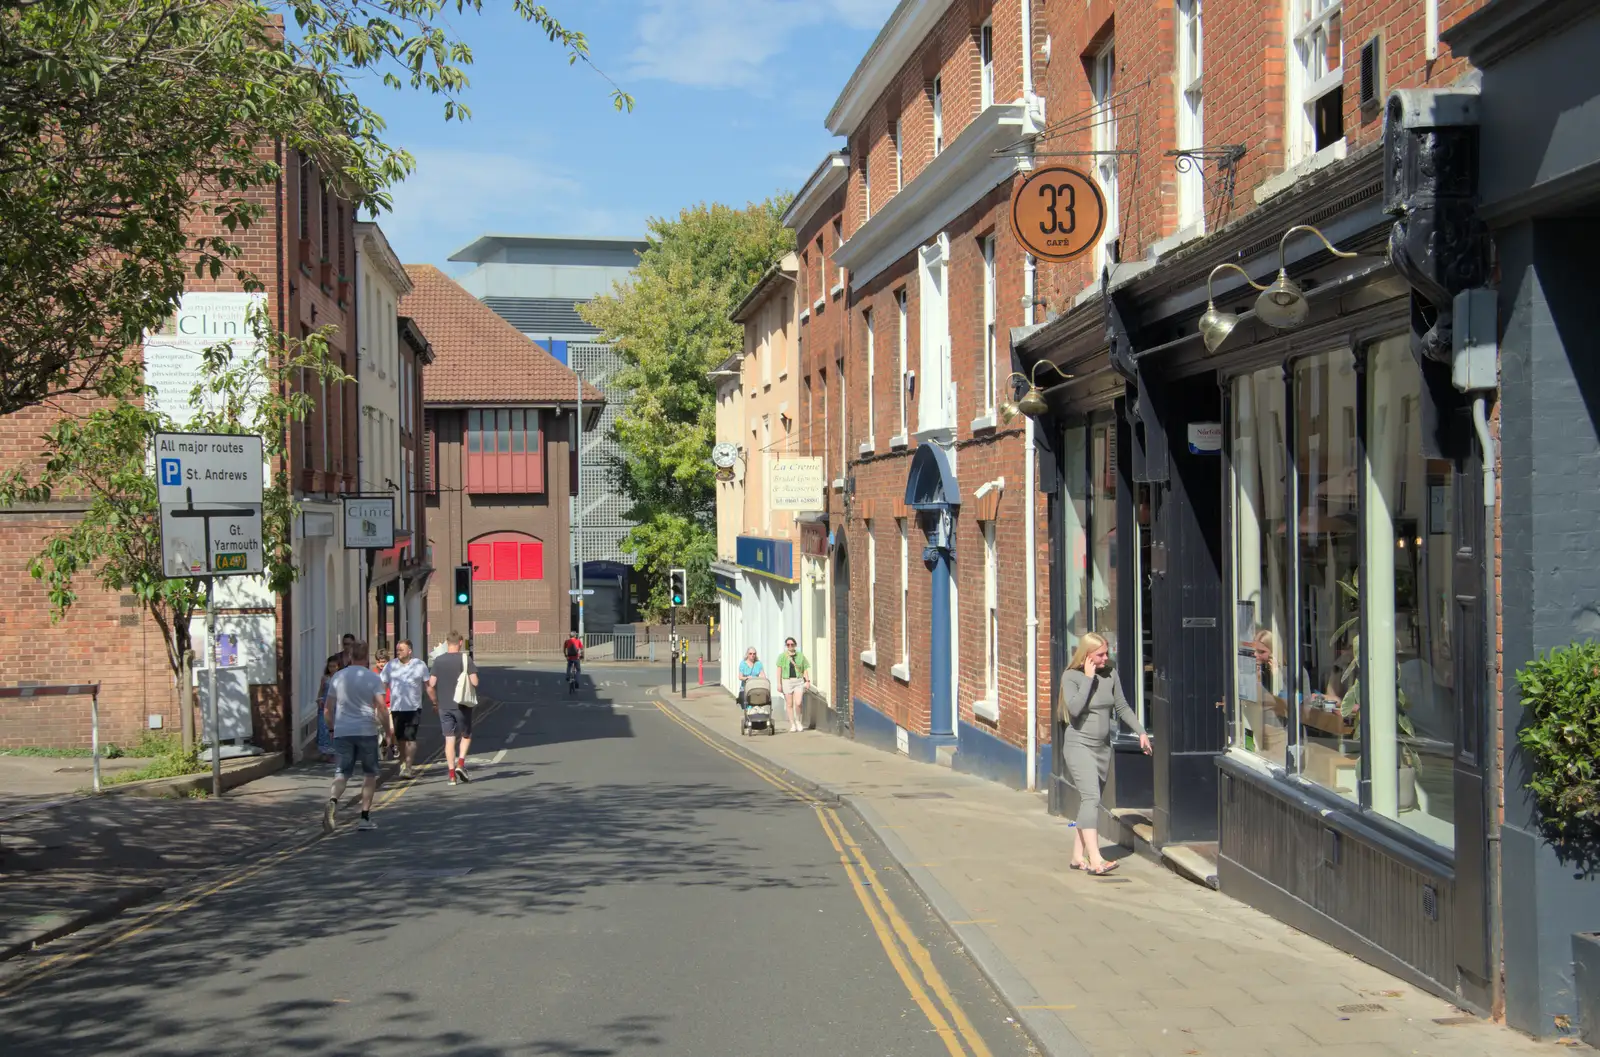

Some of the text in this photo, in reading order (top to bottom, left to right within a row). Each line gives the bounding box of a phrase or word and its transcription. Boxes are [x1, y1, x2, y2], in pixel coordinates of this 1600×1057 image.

[1038, 183, 1076, 235] 33
[1046, 238, 1070, 247] CAFÉ
[179, 314, 248, 335] Clini
[151, 370, 201, 379] physiotherap
[158, 387, 189, 395] erbalism
[160, 440, 244, 455] All major routes
[165, 461, 247, 483] P St. Andrews
[348, 505, 391, 518] Clinic
[229, 524, 244, 536] Gt.
[214, 538, 258, 551] Yarmouth
